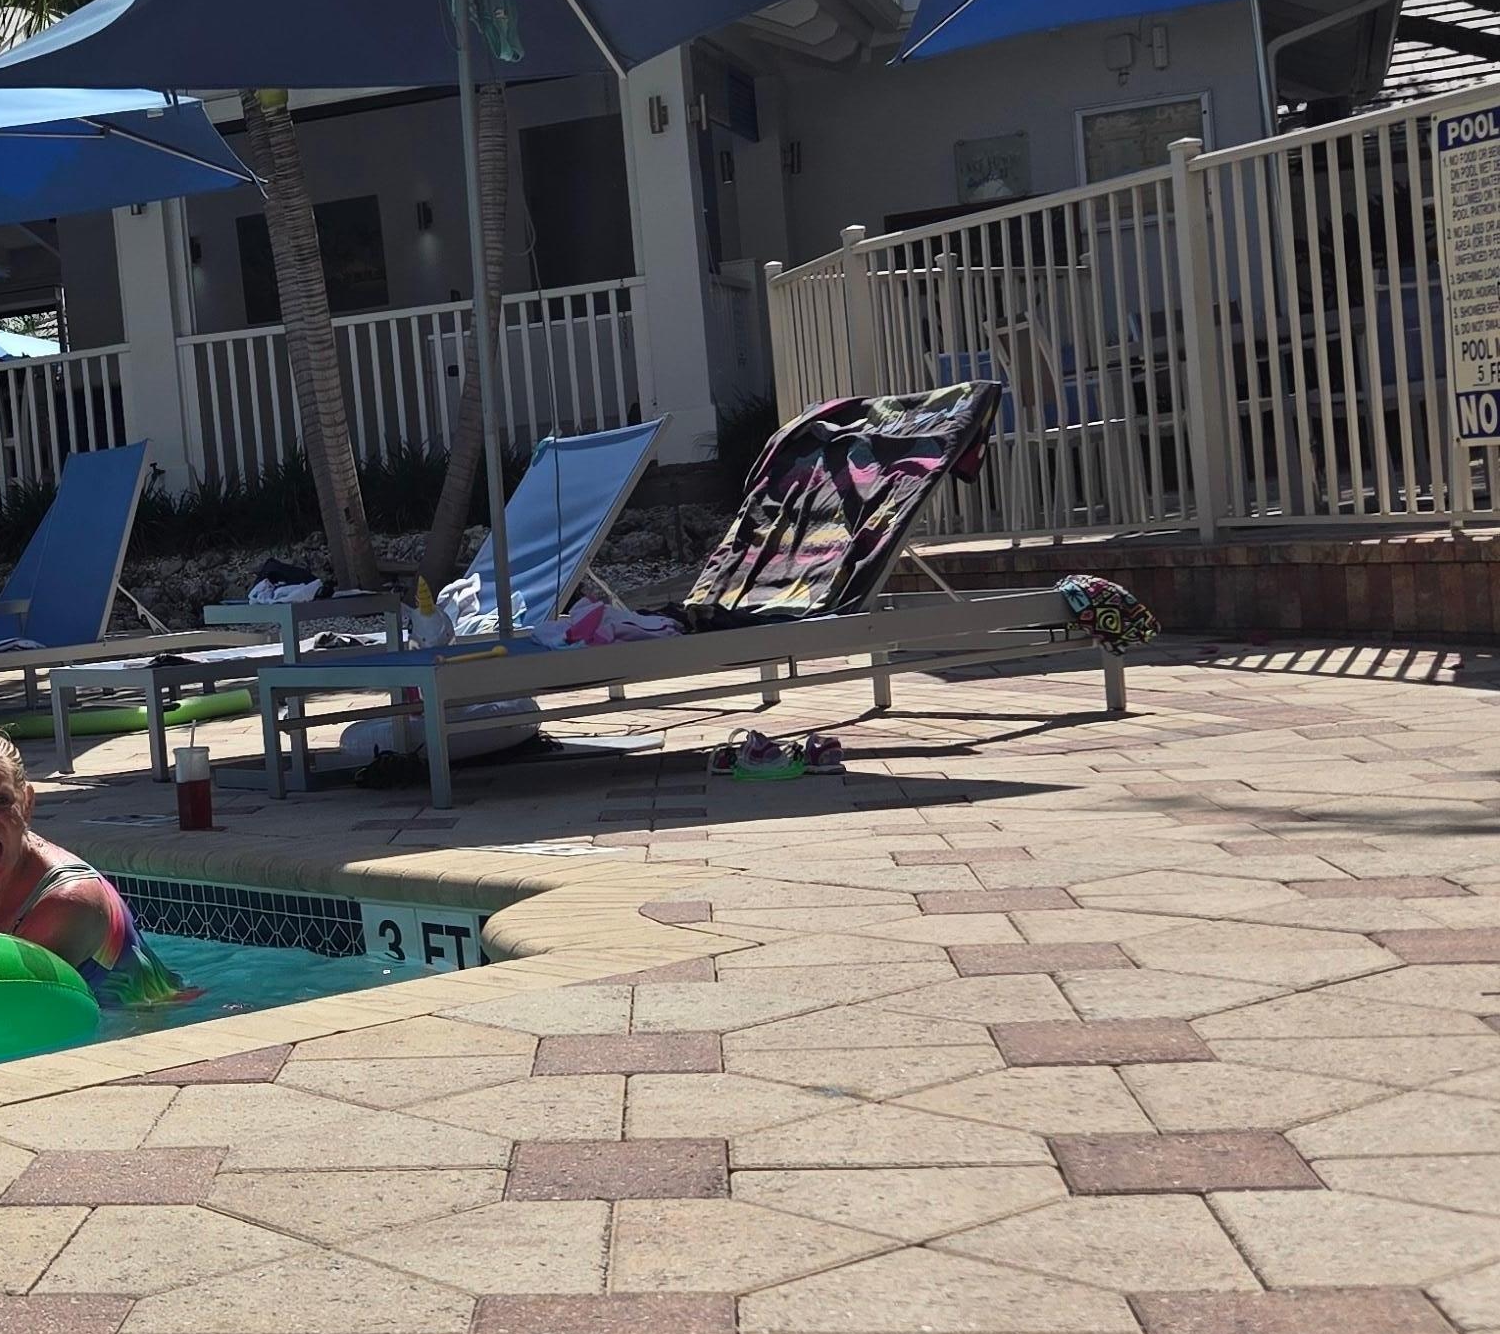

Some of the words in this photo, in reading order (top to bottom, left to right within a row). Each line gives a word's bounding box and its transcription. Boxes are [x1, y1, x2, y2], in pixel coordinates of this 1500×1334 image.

[1447, 113, 1499, 146] POOL
[1461, 338, 1494, 362] POOL
[1477, 365, 1485, 382] 5
[1459, 392, 1498, 436] NO
[378, 919, 406, 964] 3
[421, 921, 471, 971] FT
